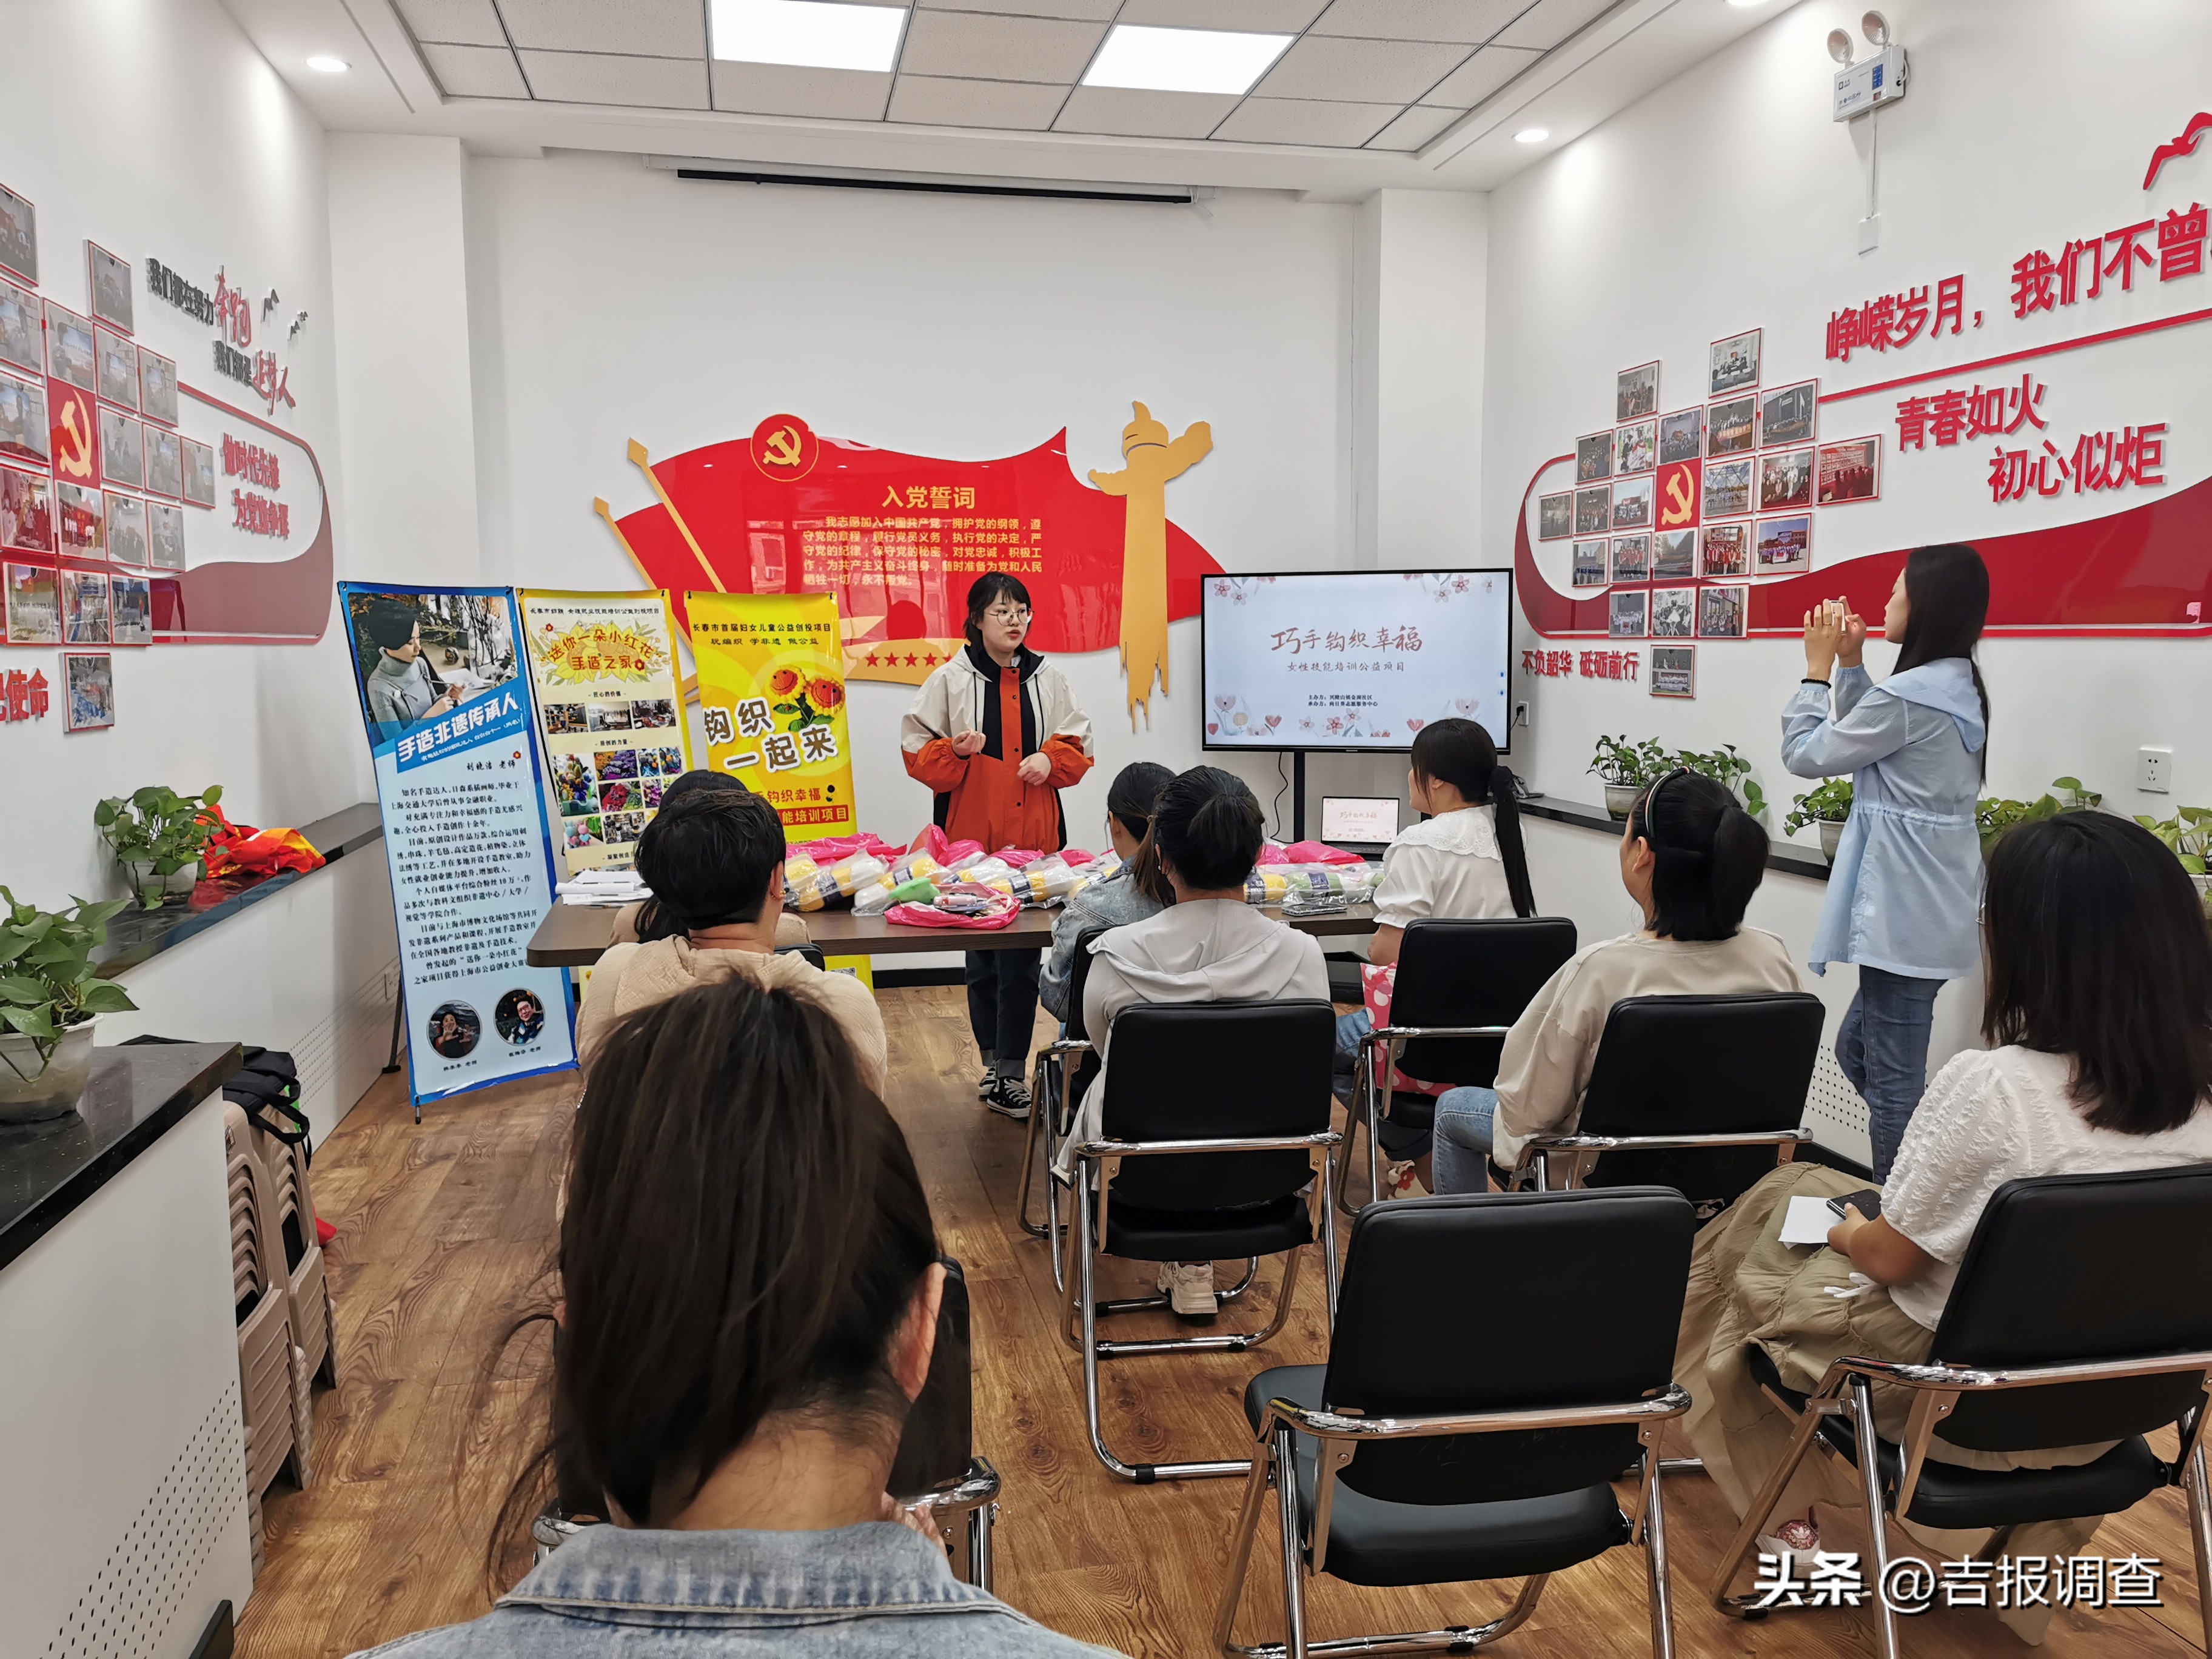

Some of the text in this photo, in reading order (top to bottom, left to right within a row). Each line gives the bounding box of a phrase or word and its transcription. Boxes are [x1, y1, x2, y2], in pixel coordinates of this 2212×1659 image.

[1825, 202, 2207, 363] 峥嵘岁月，我们不曾
[1895, 373, 2046, 451] 青春如火
[1988, 423, 2168, 502] 初心似炬
[882, 485, 975, 509] 入党誓词
[825, 516, 1041, 530] 我志愿加入中国共产党，拥护党的纲领，遵
[803, 530, 1042, 544] 守党的章程，履行党员义务，执行党的决定，严
[803, 545, 1042, 558] 守党的纪律，保守党的秘密，对党忠诚，积极工
[803, 559, 1042, 572] 作，为共产主义奋斗终身，随时准备为党和人民
[803, 574, 912, 586] 牺牲一切，永不叛党。
[692, 623, 831, 632] 长春市首届妇女儿童公益创投项目
[1270, 625, 1423, 654] 巧手钩织幸福
[571, 655, 632, 671] 手造之家
[1287, 661, 1404, 672] 女性技能培训公益项目
[1522, 649, 1638, 680] 不负韶华 砥砺前行
[398, 692, 518, 762] 手造非遗传承人
[704, 700, 771, 741] 钩织
[728, 727, 835, 769] 一起来
[499, 760, 515, 770] 老师
[756, 788, 821, 803] 钩织幸福
[777, 807, 847, 823] 能培训项目
[414, 960, 528, 985] 之家项目获得上海市公益创业大赛
